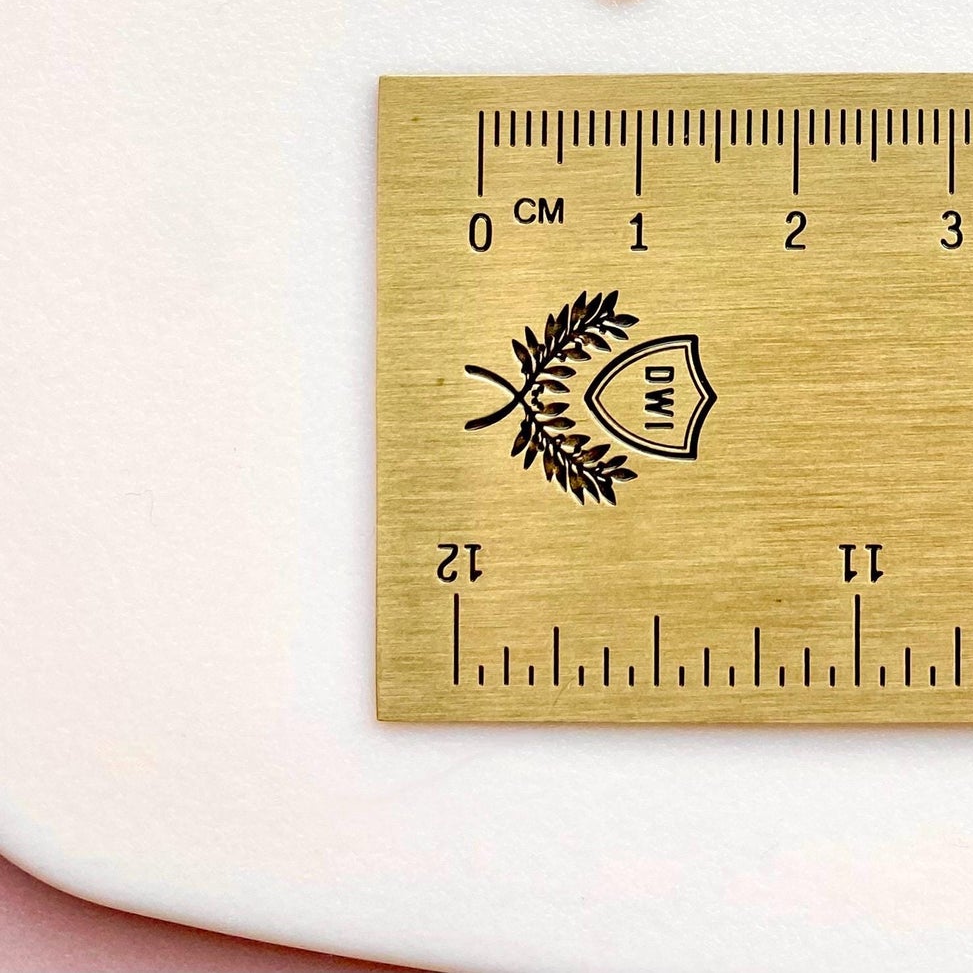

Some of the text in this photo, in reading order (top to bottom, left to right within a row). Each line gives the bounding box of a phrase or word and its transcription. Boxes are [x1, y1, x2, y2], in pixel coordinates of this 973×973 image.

[513, 197, 564, 224] CM
[784, 210, 807, 250] 2
[940, 210, 964, 250] 3
[468, 212, 493, 253] 0
[629, 212, 649, 252] 1
[644, 365, 675, 430] DWI
[436, 543, 483, 583] 12
[838, 543, 884, 583] 11
